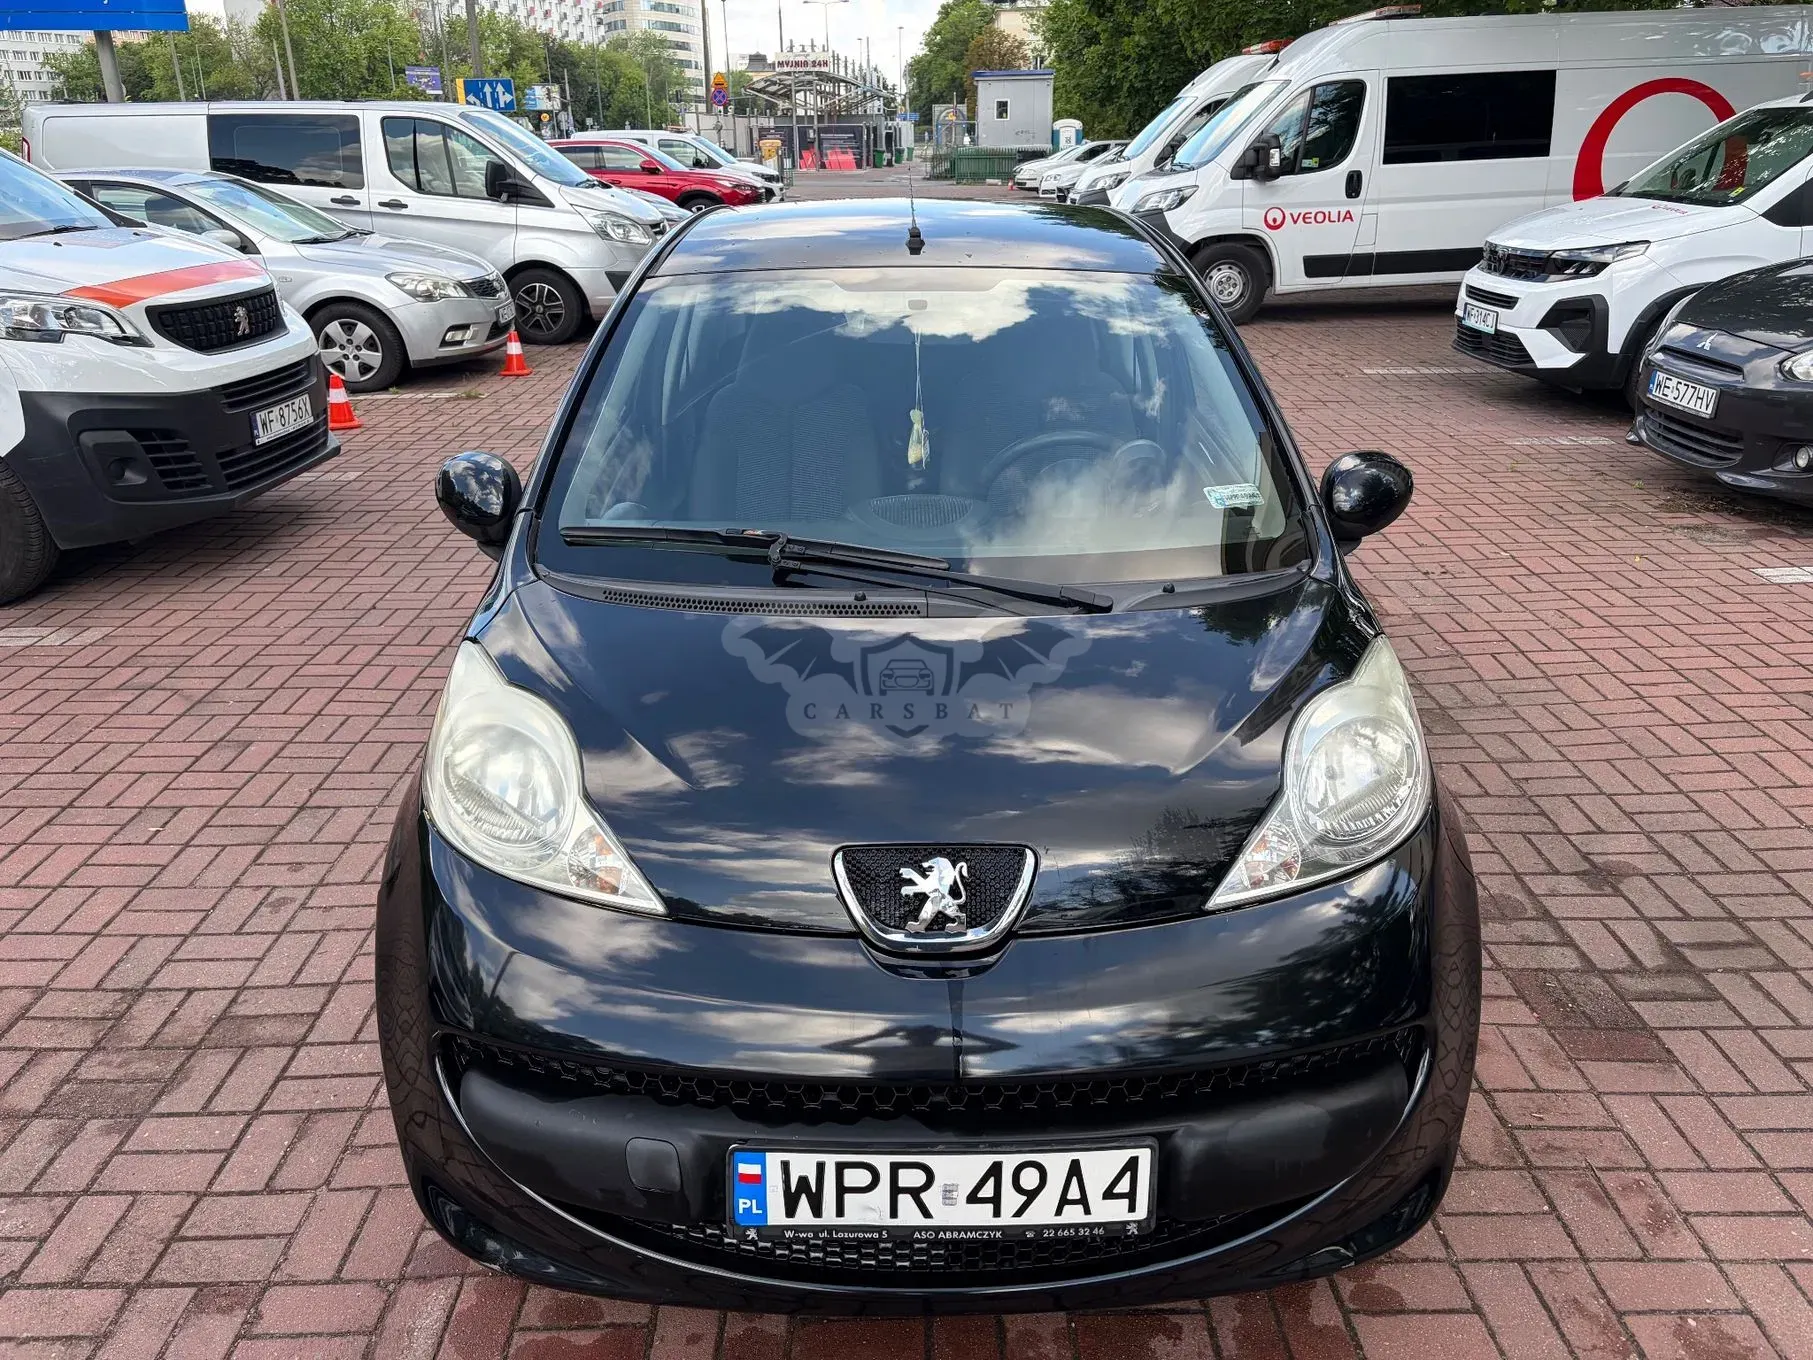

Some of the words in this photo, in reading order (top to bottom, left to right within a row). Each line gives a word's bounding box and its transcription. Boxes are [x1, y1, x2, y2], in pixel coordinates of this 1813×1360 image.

[1289, 210, 1355, 225] VEOLIA
[1654, 374, 1673, 397] WE
[1673, 381, 1715, 411] 577HV
[259, 410, 274, 435] WF
[279, 396, 310, 427] 8756X
[780, 1159, 936, 1219] WPR
[965, 1155, 1140, 1219] 49A4
[738, 1198, 763, 1214] PL
[784, 1230, 814, 1239] W-wa
[818, 1229, 831, 1239] ul.
[832, 1229, 879, 1239] Lazurowa
[913, 1230, 935, 1239] ASO
[938, 1230, 1002, 1239] ABRAMCZYK
[1043, 1228, 1055, 1238] 22
[1057, 1228, 1075, 1237] 665
[1078, 1227, 1090, 1236] 32
[1092, 1226, 1105, 1236] 46
